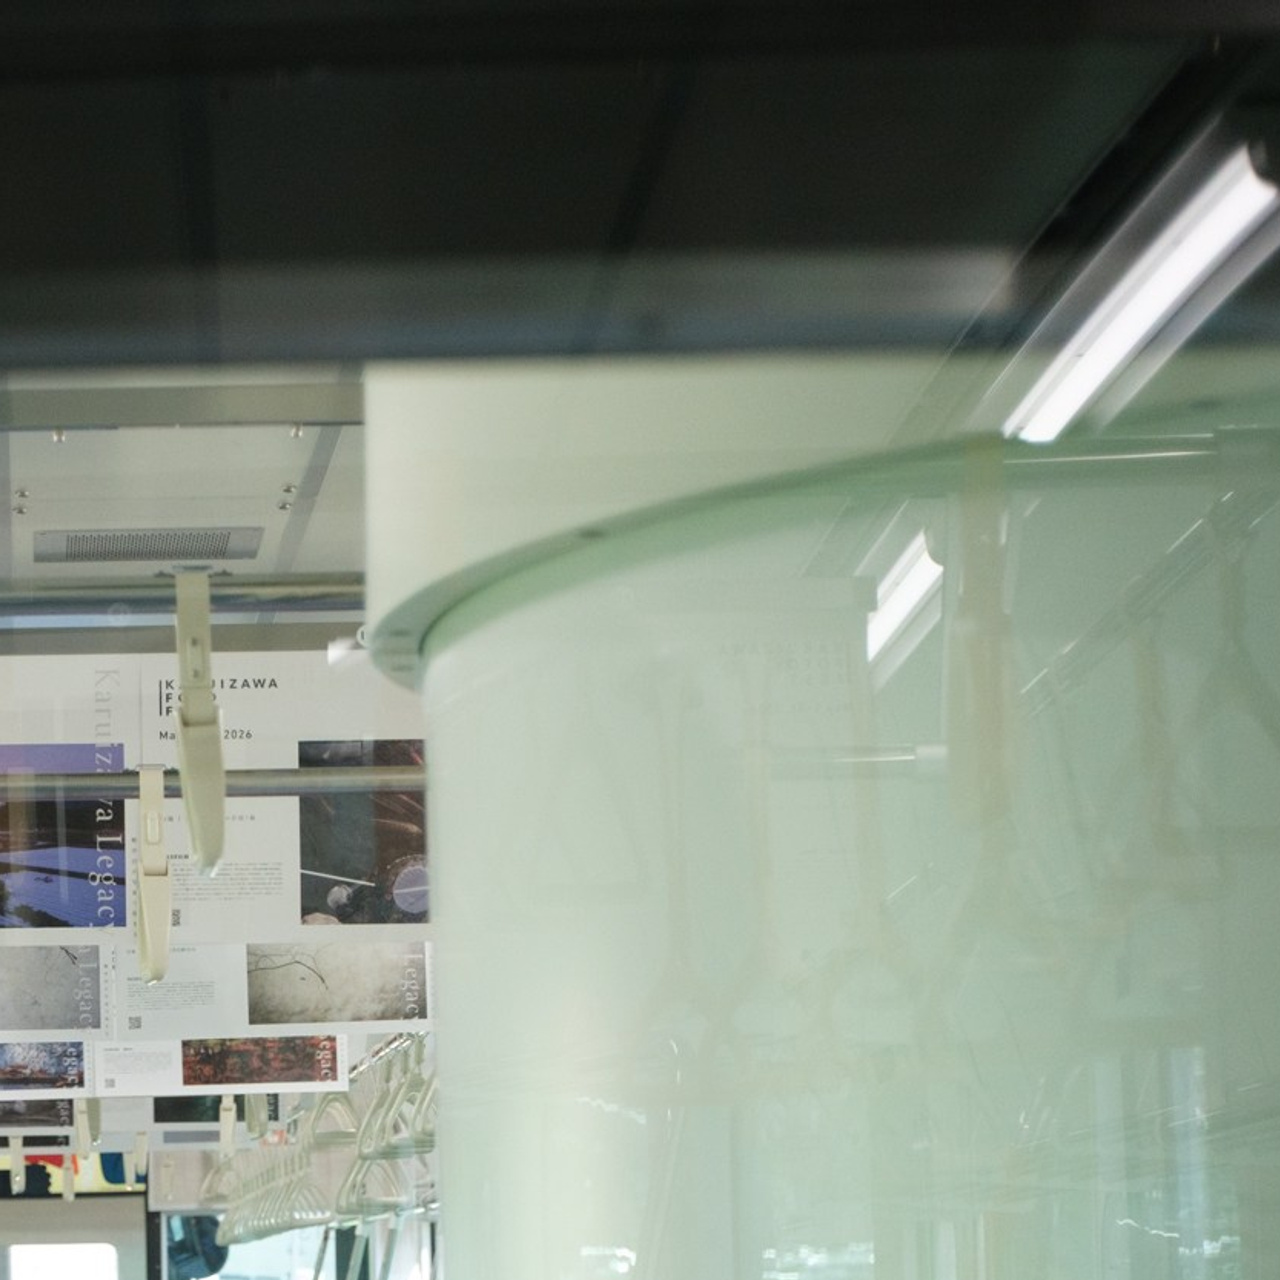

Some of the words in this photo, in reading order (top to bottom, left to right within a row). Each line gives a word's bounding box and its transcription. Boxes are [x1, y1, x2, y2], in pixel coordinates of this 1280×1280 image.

[223, 729, 253, 740] 2026
[88, 834, 123, 932] Legac
[73, 962, 98, 1030] Legac
[401, 953, 424, 1020] Legac
